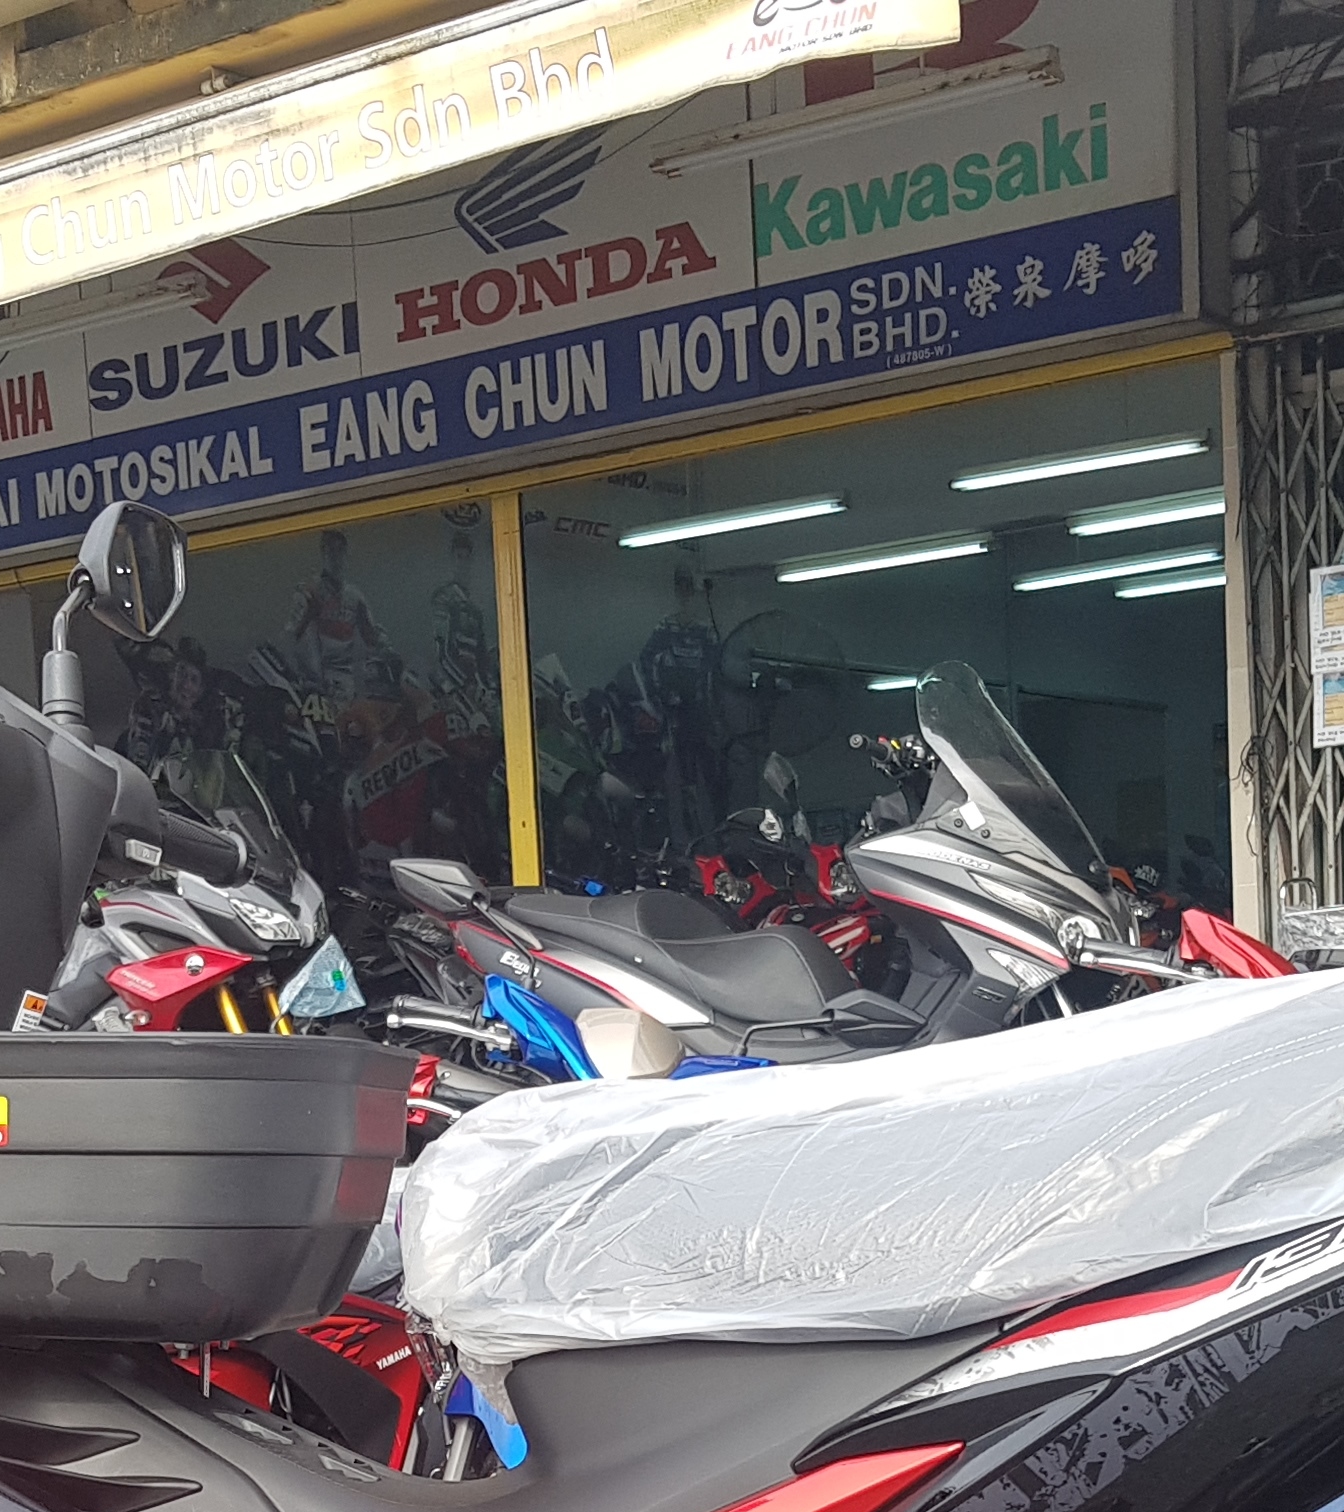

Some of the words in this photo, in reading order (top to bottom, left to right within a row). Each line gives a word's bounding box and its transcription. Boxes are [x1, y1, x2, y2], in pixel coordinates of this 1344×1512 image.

[20, 195, 154, 267] Chun
[168, 126, 342, 226] Motor
[356, 83, 472, 172] Sdn
[490, 27, 616, 128] Bhd
[756, 101, 1110, 258] Kawasaki
[395, 220, 717, 344] HONDA
[849, 261, 958, 316] SDN.
[851, 306, 961, 360] BHD.
[35, 426, 274, 521] MOTOSIKAL
[297, 379, 438, 474] EANG
[463, 338, 608, 441] CHUN
[640, 286, 845, 403] MOTOR
[87, 301, 362, 413] SUZUKI
